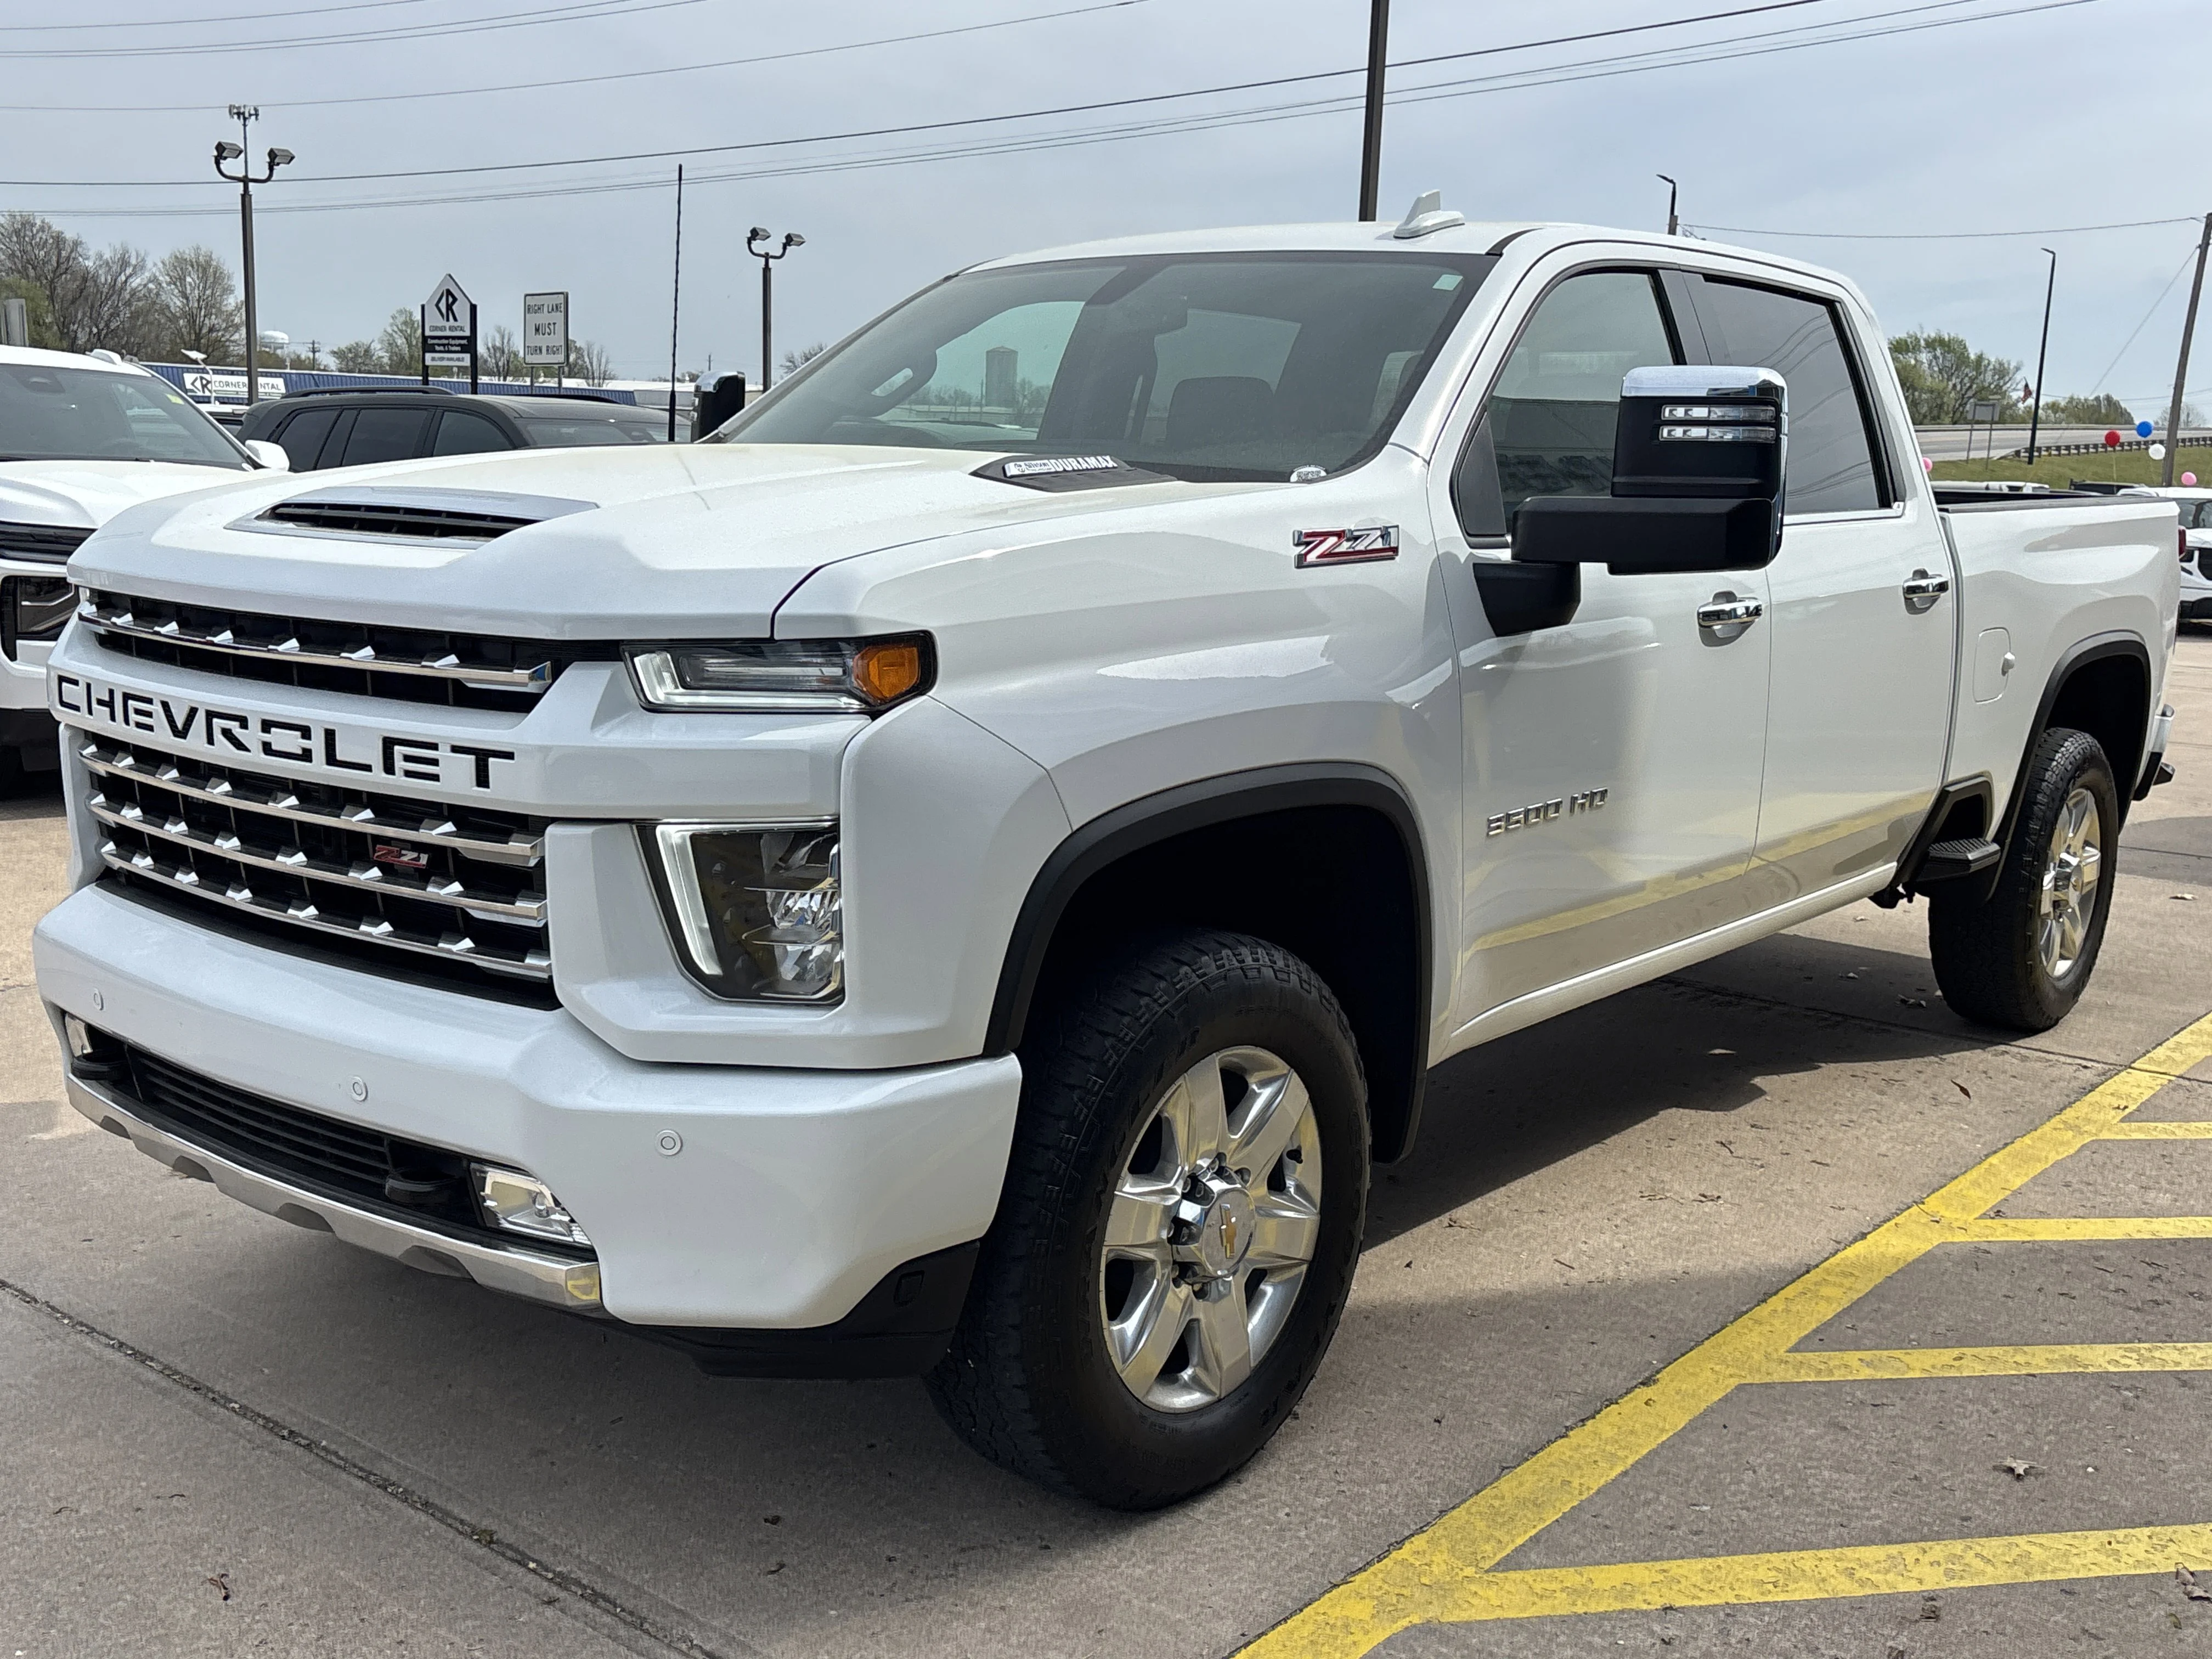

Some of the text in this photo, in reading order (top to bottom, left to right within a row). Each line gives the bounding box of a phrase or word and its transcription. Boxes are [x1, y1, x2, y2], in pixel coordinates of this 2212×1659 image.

[527, 302, 563, 314] RIGHT LANE
[534, 322, 557, 336] MUST
[527, 345, 563, 356] TURN RIGHT
[213, 380, 281, 391] CORNER NTAL
[1049, 455, 1118, 472] DURAMAX
[57, 674, 516, 788] CHEVROLET
